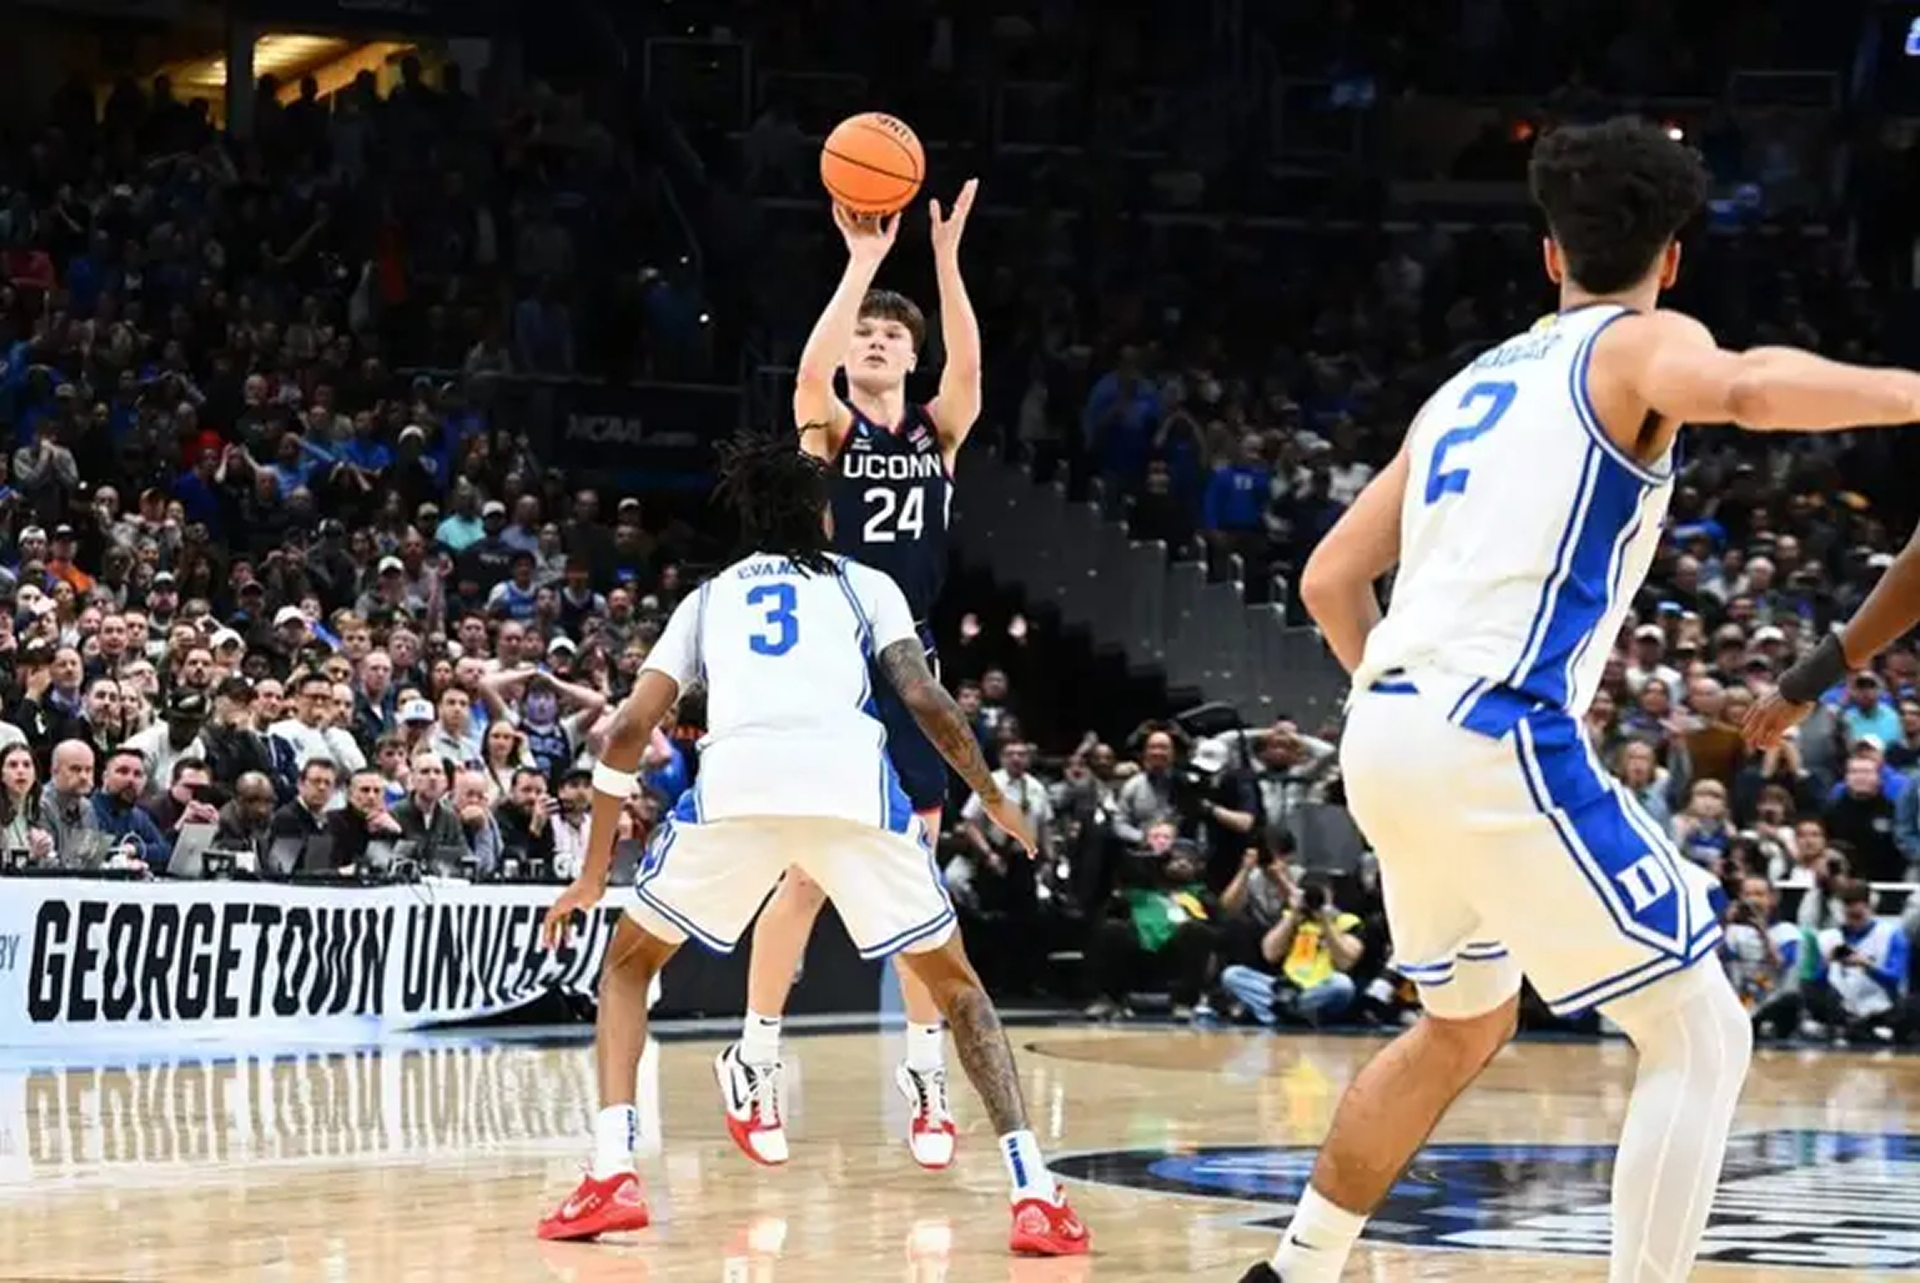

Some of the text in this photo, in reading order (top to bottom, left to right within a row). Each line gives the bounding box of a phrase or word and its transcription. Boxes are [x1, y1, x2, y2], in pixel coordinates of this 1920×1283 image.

[843, 453, 942, 479] UCONN
[1425, 380, 1518, 503] 2
[863, 486, 924, 542] 24
[746, 582, 799, 656] 3
[1615, 853, 1671, 913] D
[27, 900, 394, 1022] GEORGETOWN
[402, 904, 625, 1012] UNIVERSIT
